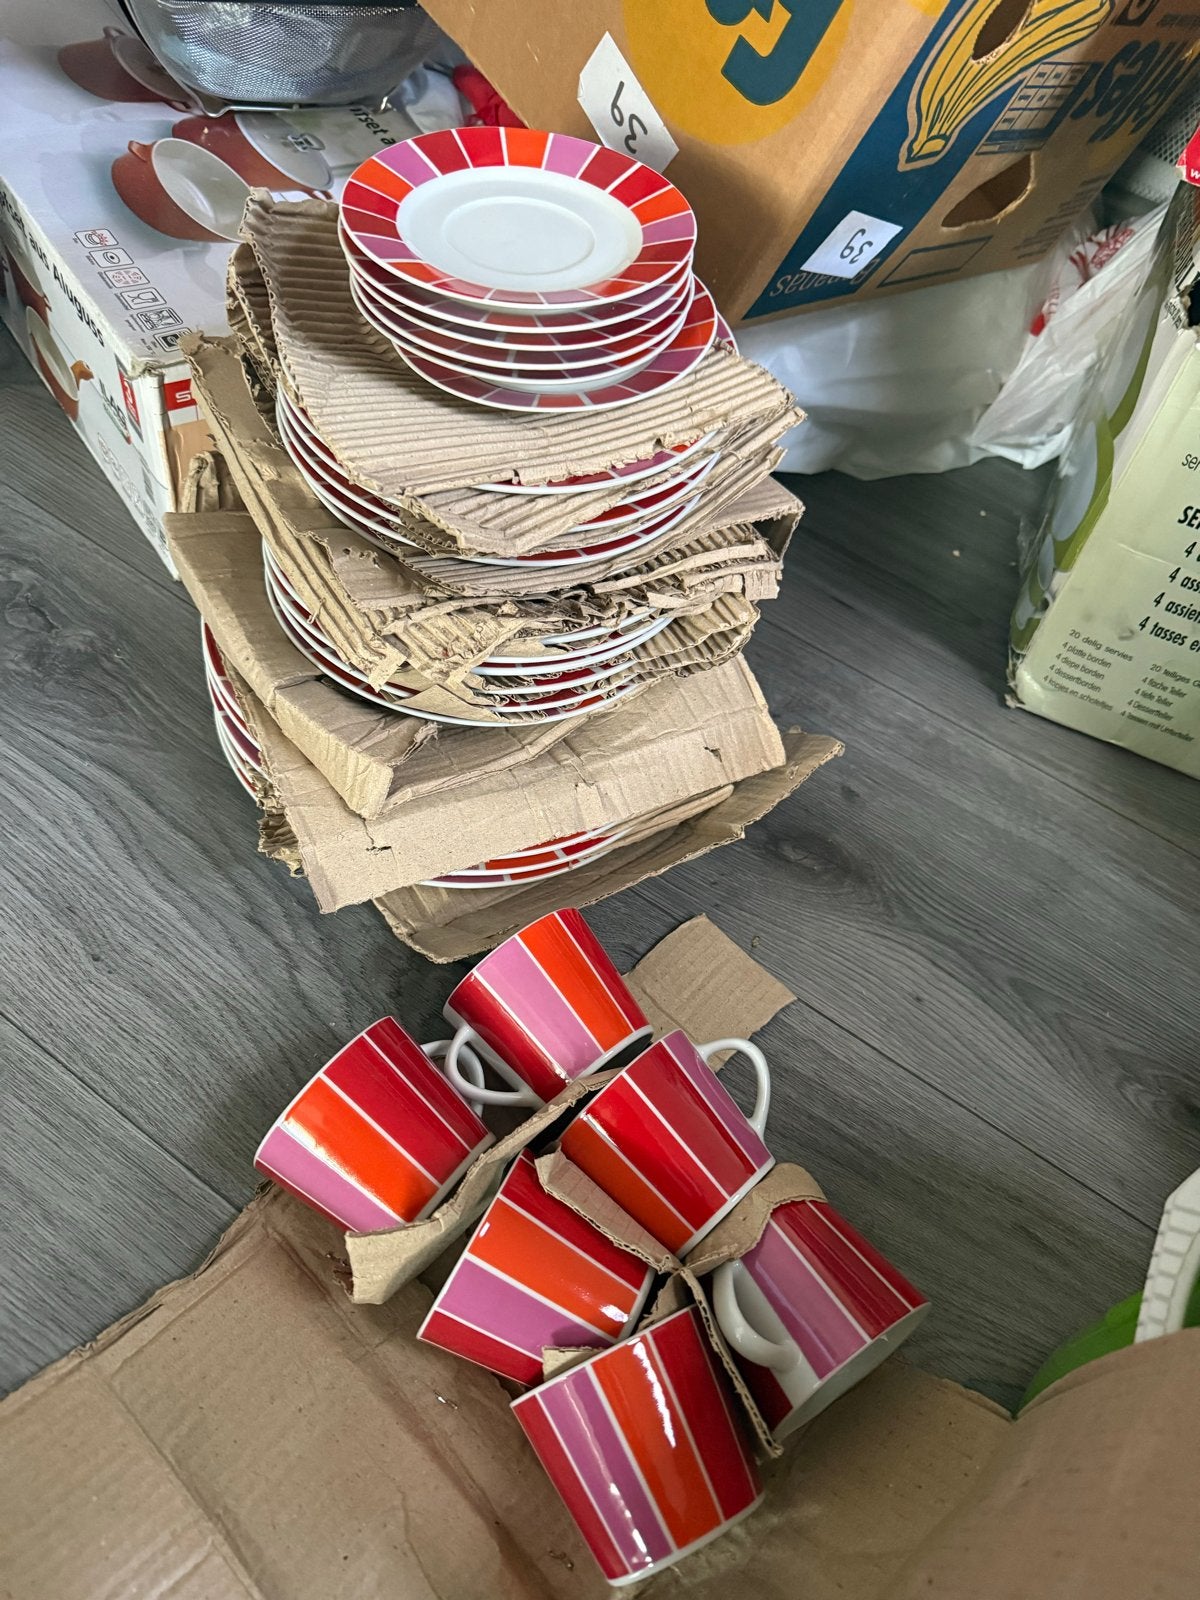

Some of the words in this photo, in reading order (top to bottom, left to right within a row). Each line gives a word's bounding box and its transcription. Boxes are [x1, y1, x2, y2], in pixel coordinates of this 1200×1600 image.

[610, 80, 649, 155] 39
[839, 227, 874, 265] 39
[28, 231, 51, 272] aus
[52, 262, 105, 348] Aluguss
[1184, 541, 1198, 558] 4
[1168, 566, 1182, 583] 4
[1153, 591, 1166, 607] 4
[1068, 628, 1081, 640] 20
[1081, 636, 1103, 651] delig
[1138, 616, 1151, 631] 4
[1149, 621, 1189, 647] tasses
[1062, 641, 1069, 649] 4
[1149, 663, 1162, 673] 20
[1141, 676, 1149, 684] 4
